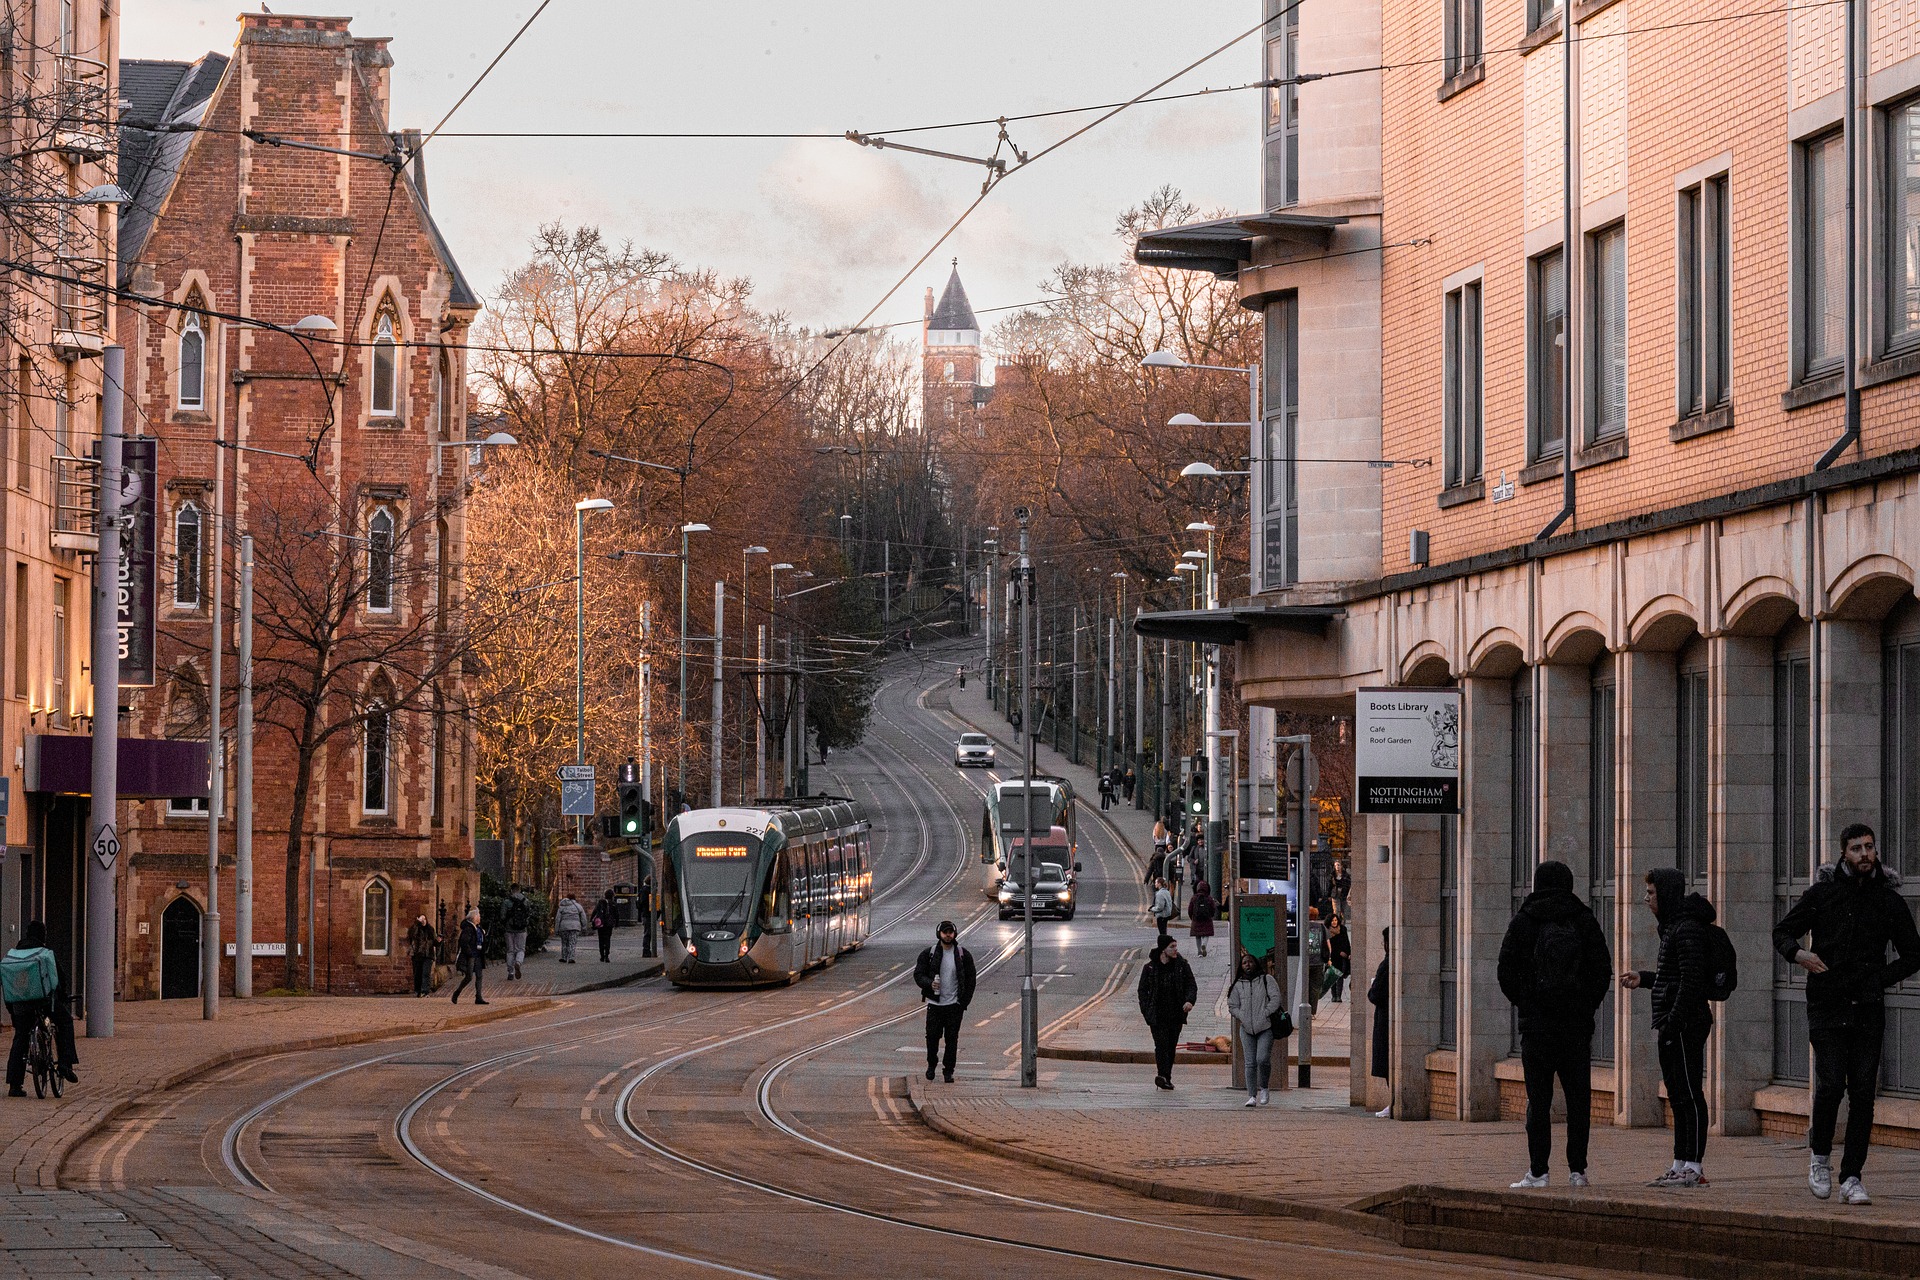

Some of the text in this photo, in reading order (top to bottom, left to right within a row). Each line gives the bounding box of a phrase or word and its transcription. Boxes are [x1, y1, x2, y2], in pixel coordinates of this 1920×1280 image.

[117, 514, 135, 659] Pmier Inn
[1370, 702, 1429, 712] Boots Library
[1369, 725, 1386, 733] Café
[1369, 787, 1443, 796] NOTTINGHAM
[1397, 797, 1444, 805] UNIVERSITY
[745, 826, 765, 836] 227
[97, 839, 118, 856] 50
[728, 847, 747, 857] Park
